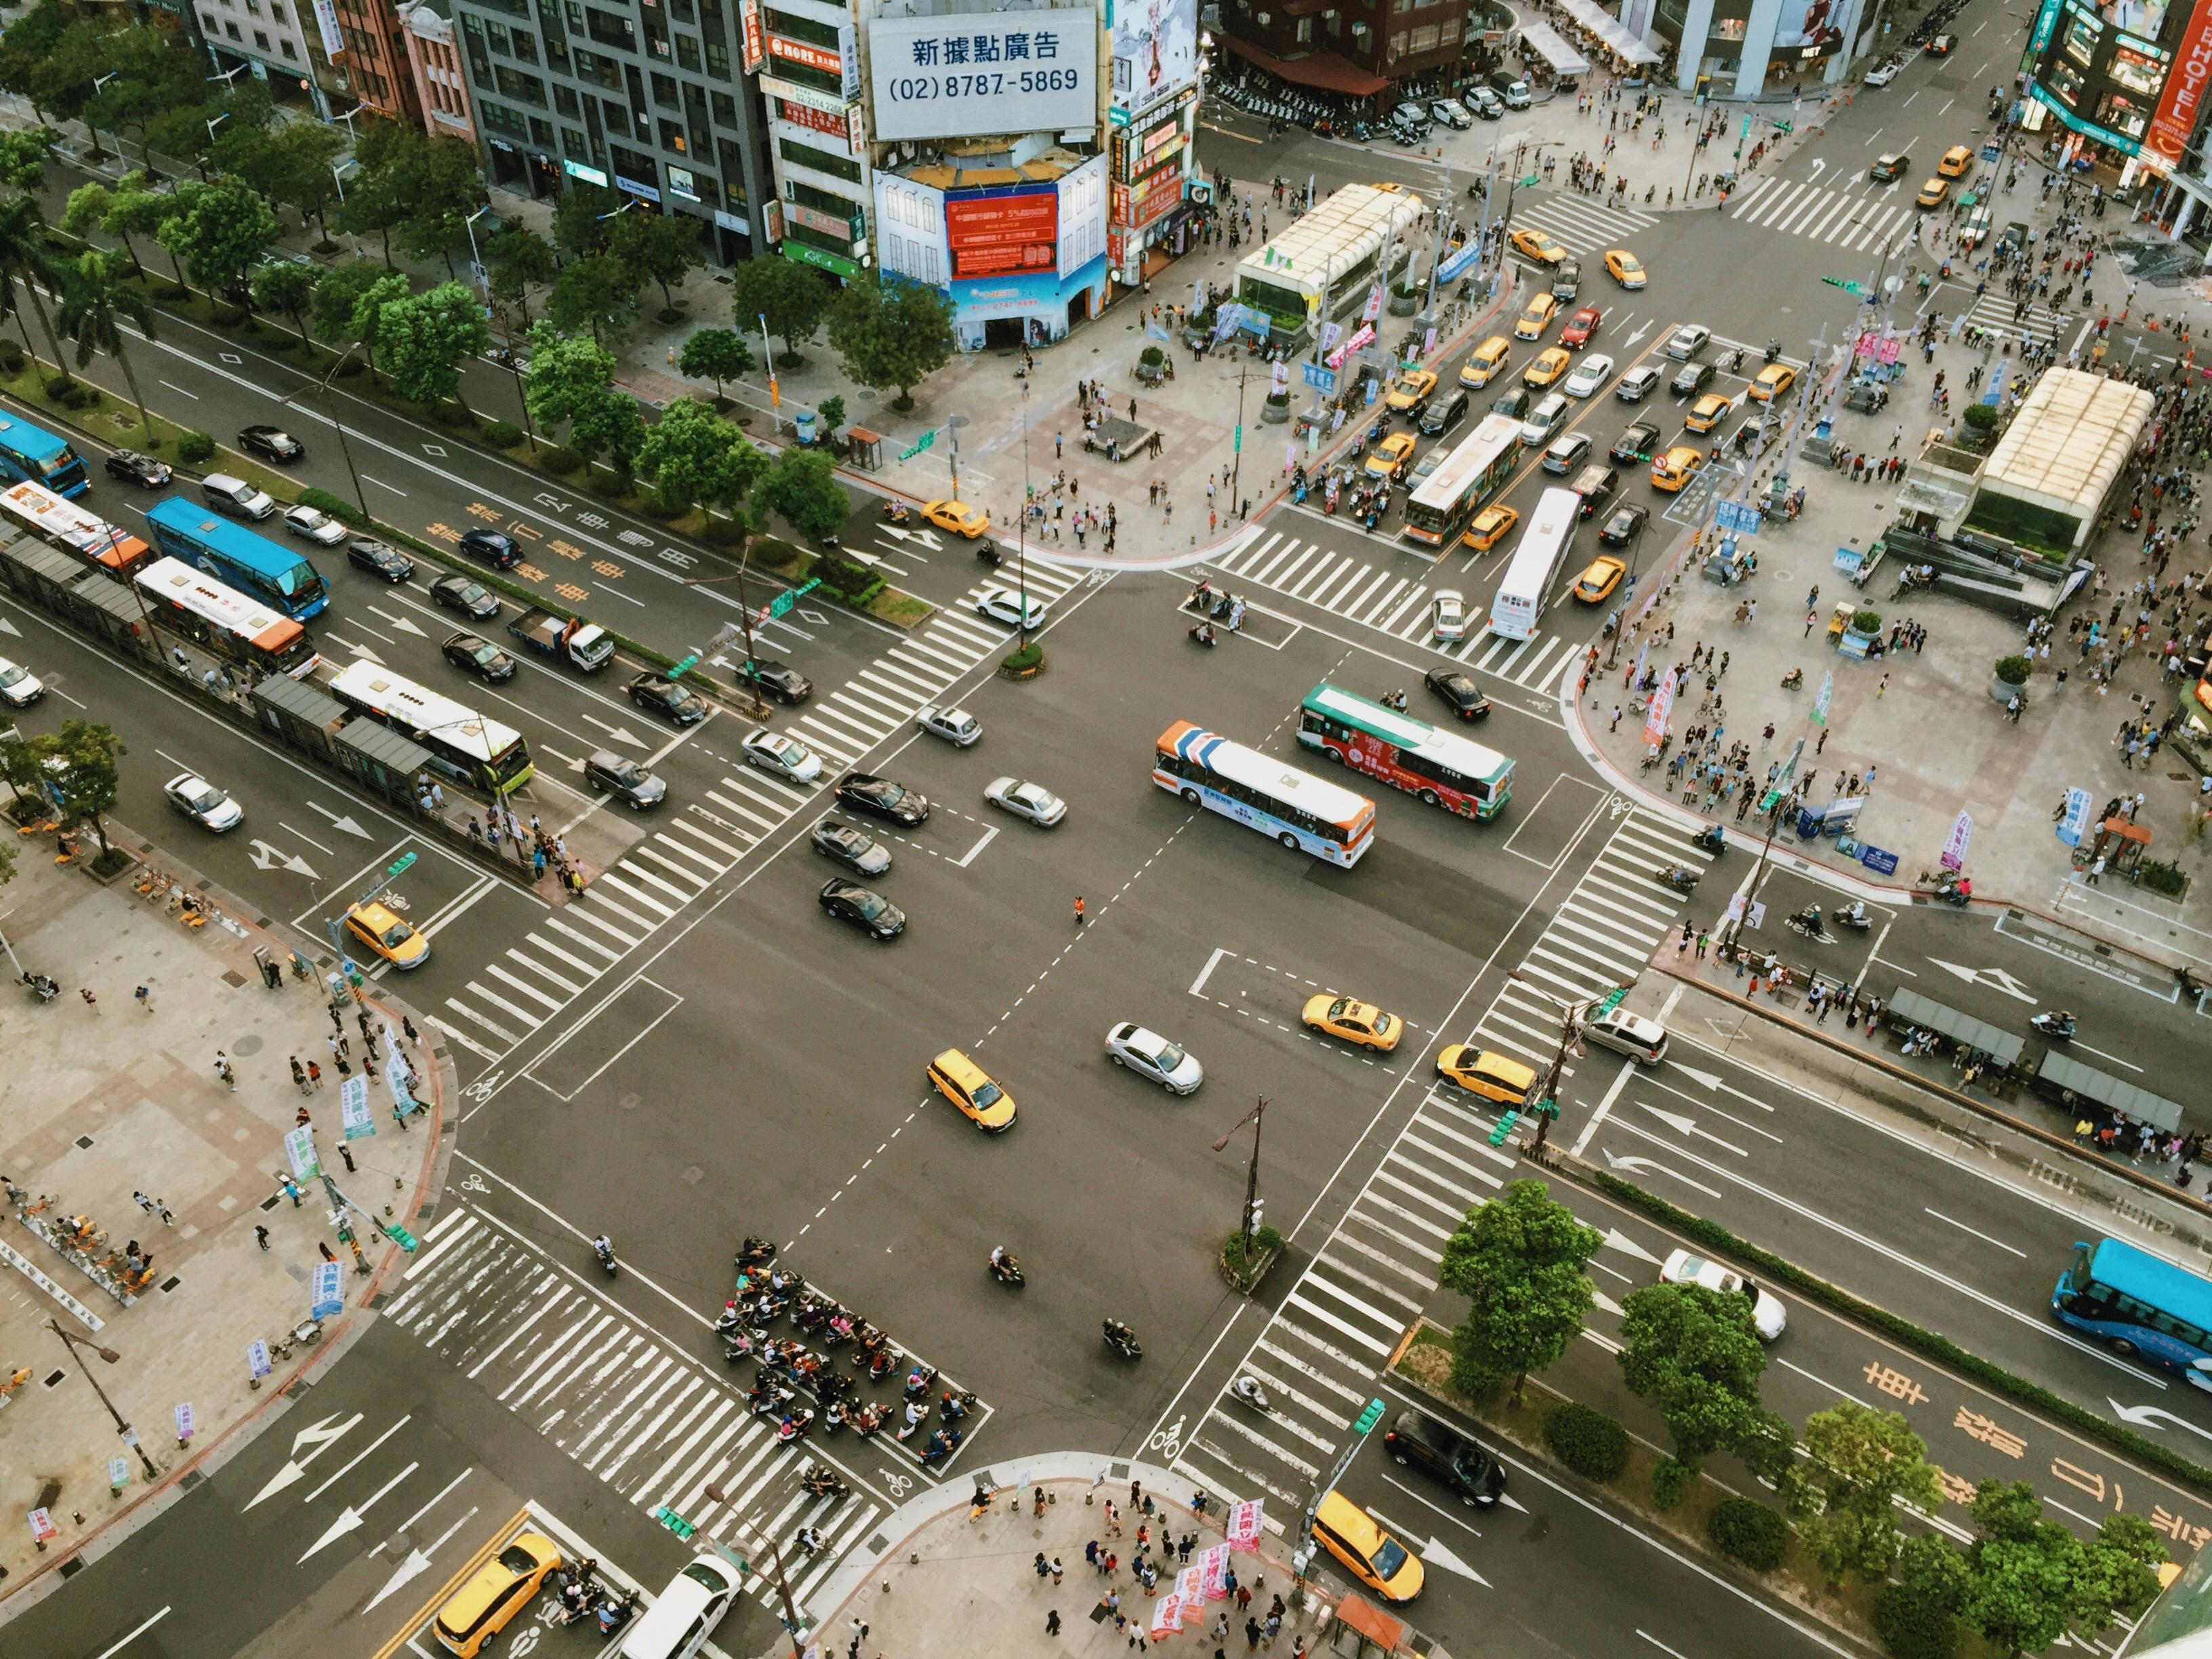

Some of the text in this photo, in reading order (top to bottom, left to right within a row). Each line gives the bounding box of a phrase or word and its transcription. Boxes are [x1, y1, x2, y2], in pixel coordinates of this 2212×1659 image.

[912, 31, 1060, 66] 新據點廣告
[1801, 45, 1822, 58] NET
[889, 68, 1079, 102] (02)8787-5869
[2171, 43, 2212, 122] HOTEL
[426, 522, 591, 602] 禁機車
